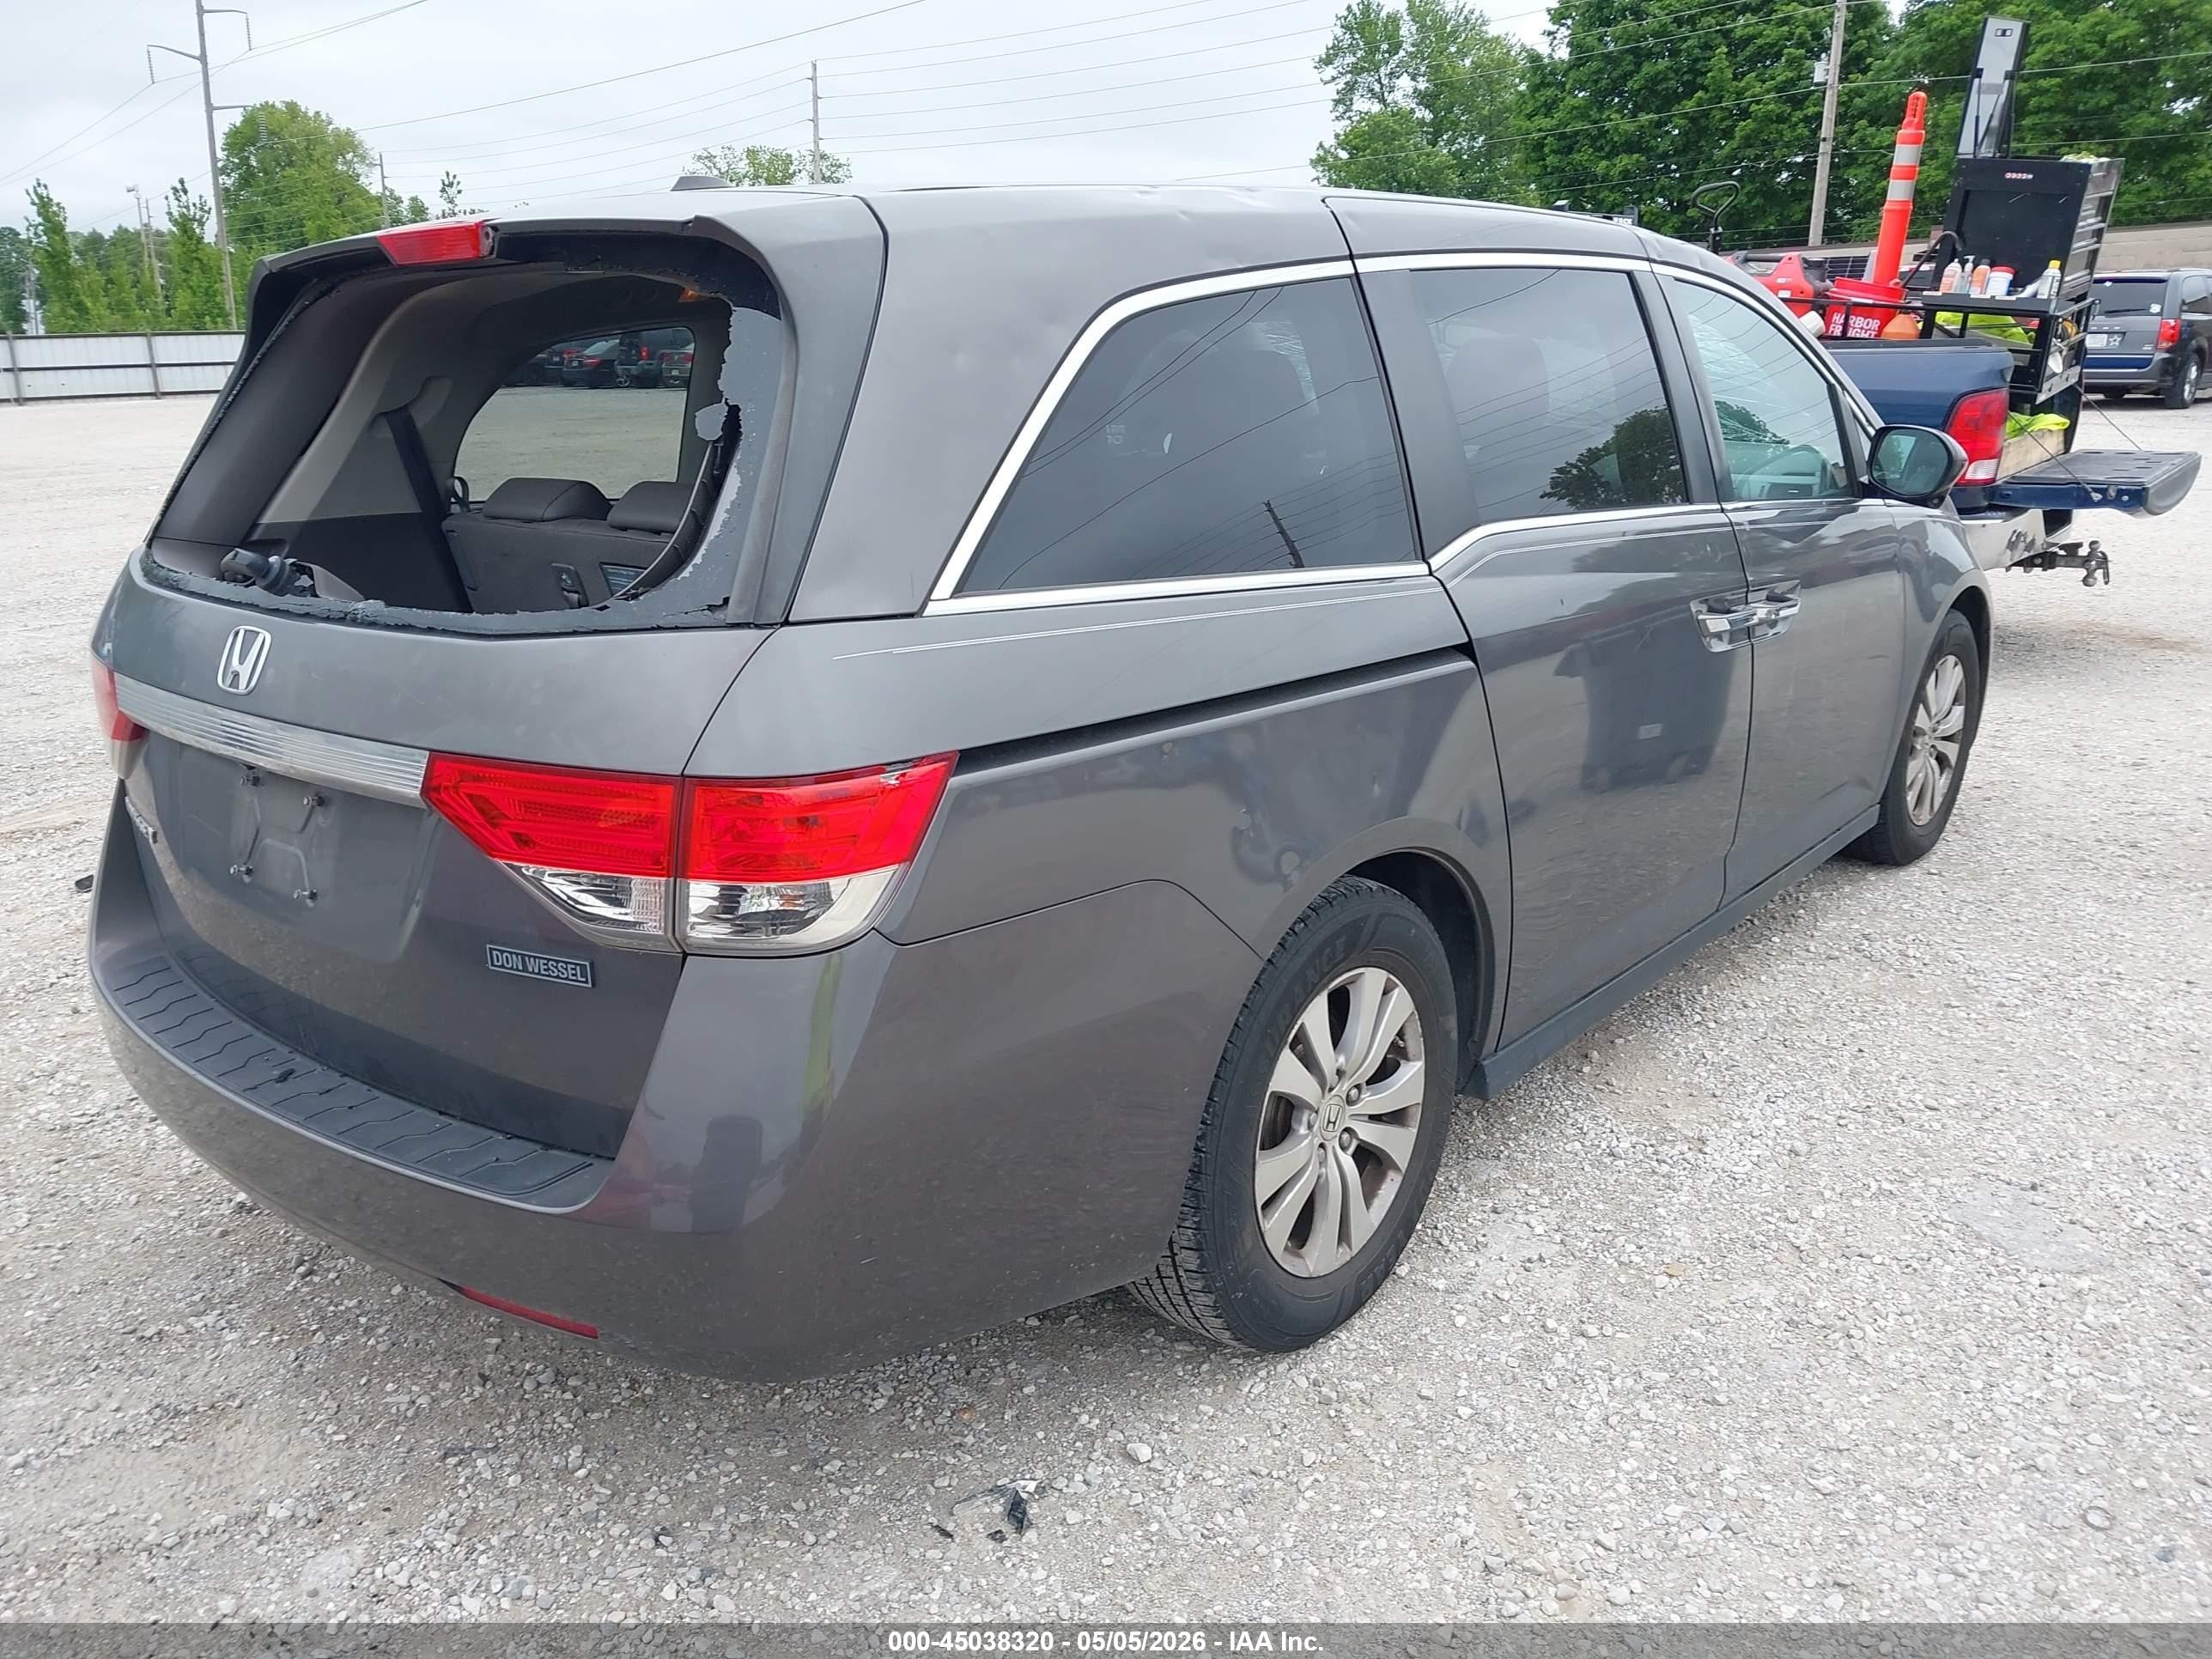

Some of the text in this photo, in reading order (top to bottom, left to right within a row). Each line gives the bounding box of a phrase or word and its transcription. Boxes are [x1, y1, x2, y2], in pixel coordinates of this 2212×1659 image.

[1828, 324, 1878, 338] FRIGHT
[493, 951, 586, 981] DON WESSEL
